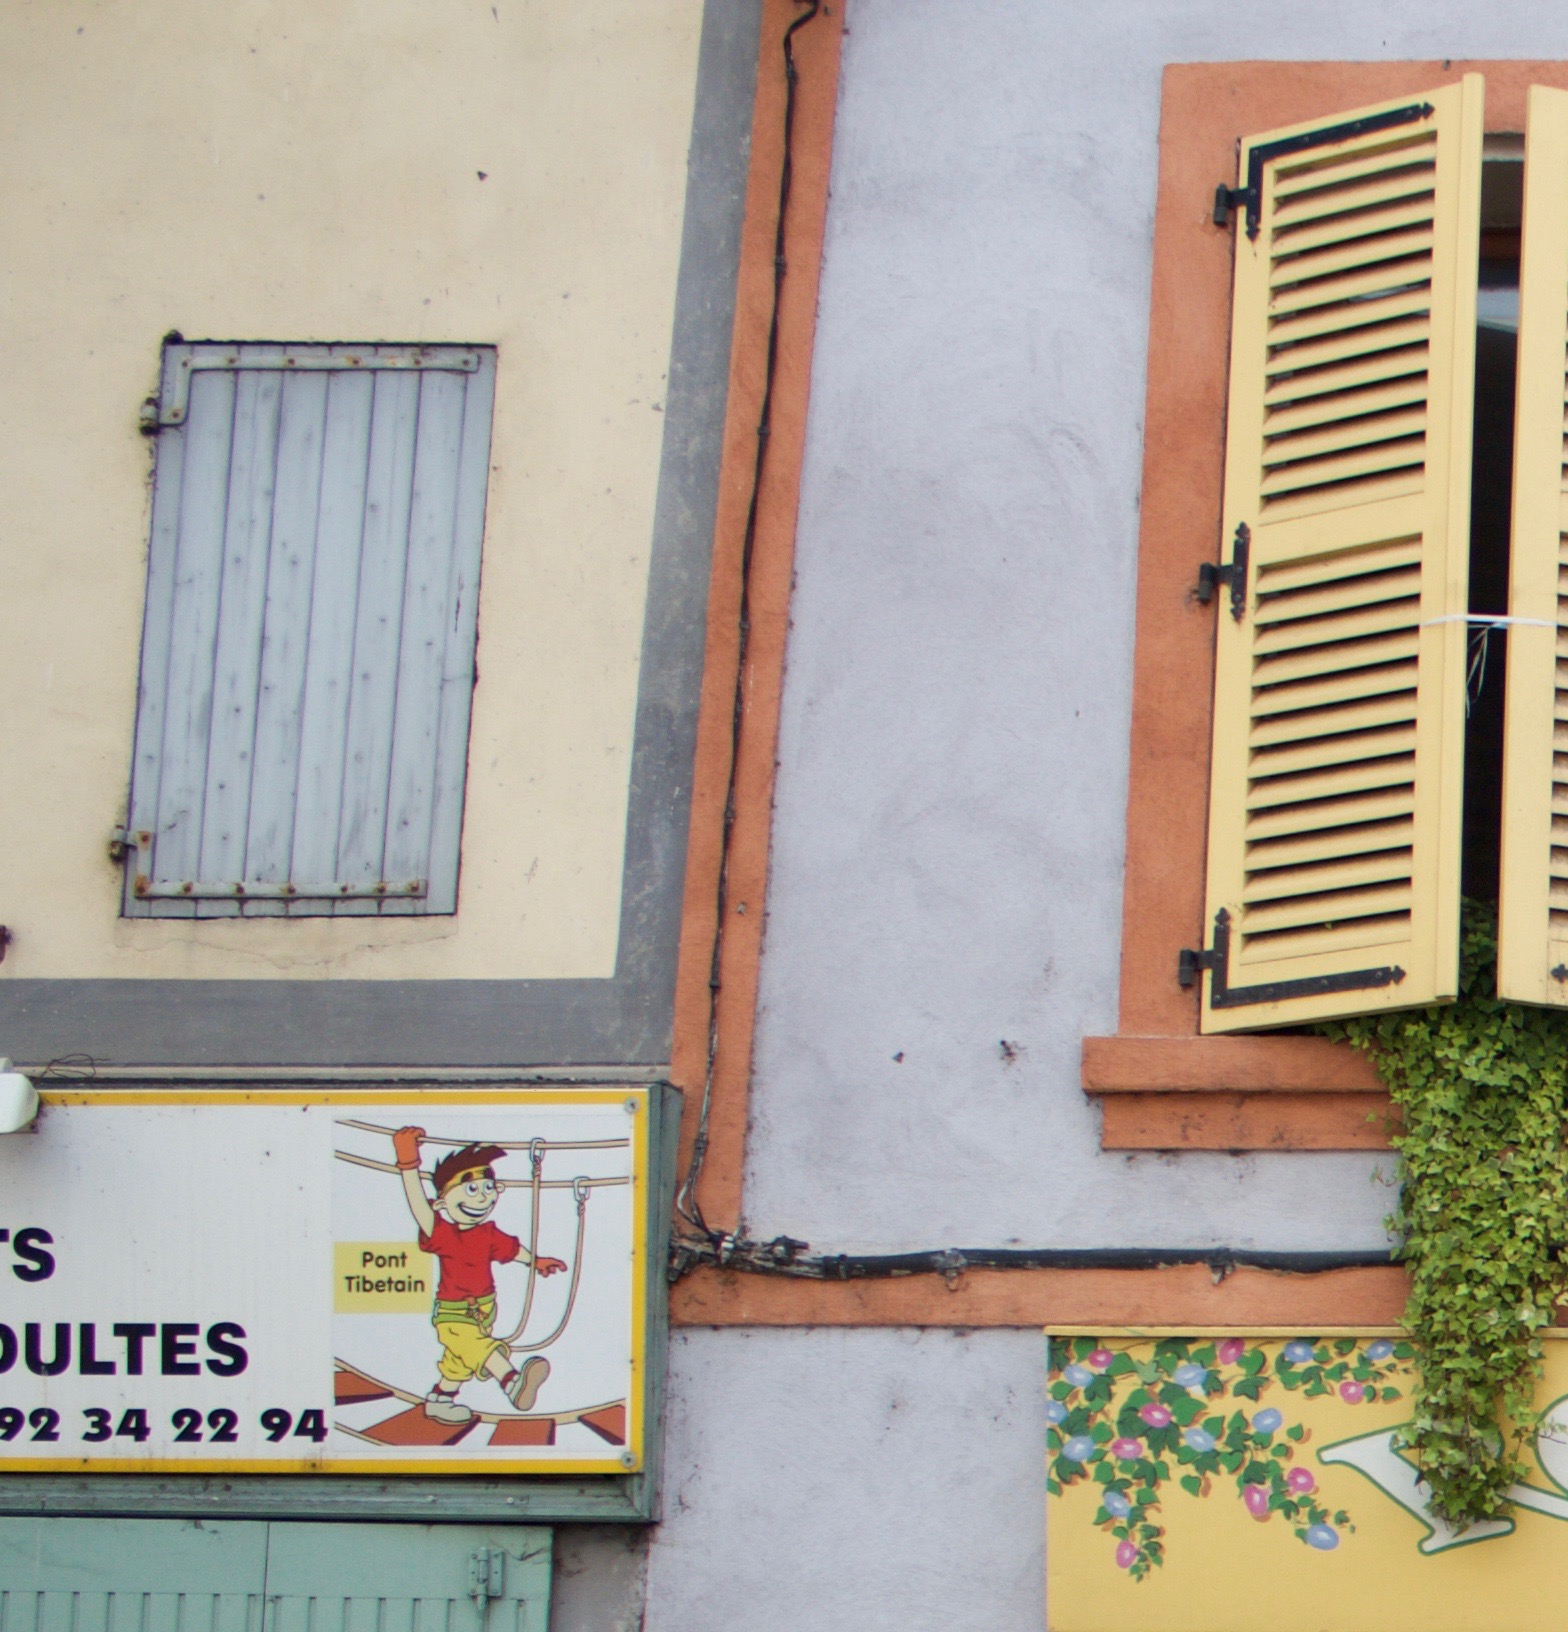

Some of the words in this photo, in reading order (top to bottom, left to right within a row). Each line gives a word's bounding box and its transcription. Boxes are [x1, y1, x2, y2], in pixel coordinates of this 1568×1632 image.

[0, 1226, 56, 1283] S
[362, 1251, 408, 1268] Pont
[344, 1275, 425, 1293] Tibetain
[81, 1407, 151, 1443] 34
[171, 1407, 239, 1442] 22
[260, 1407, 328, 1443] 94
